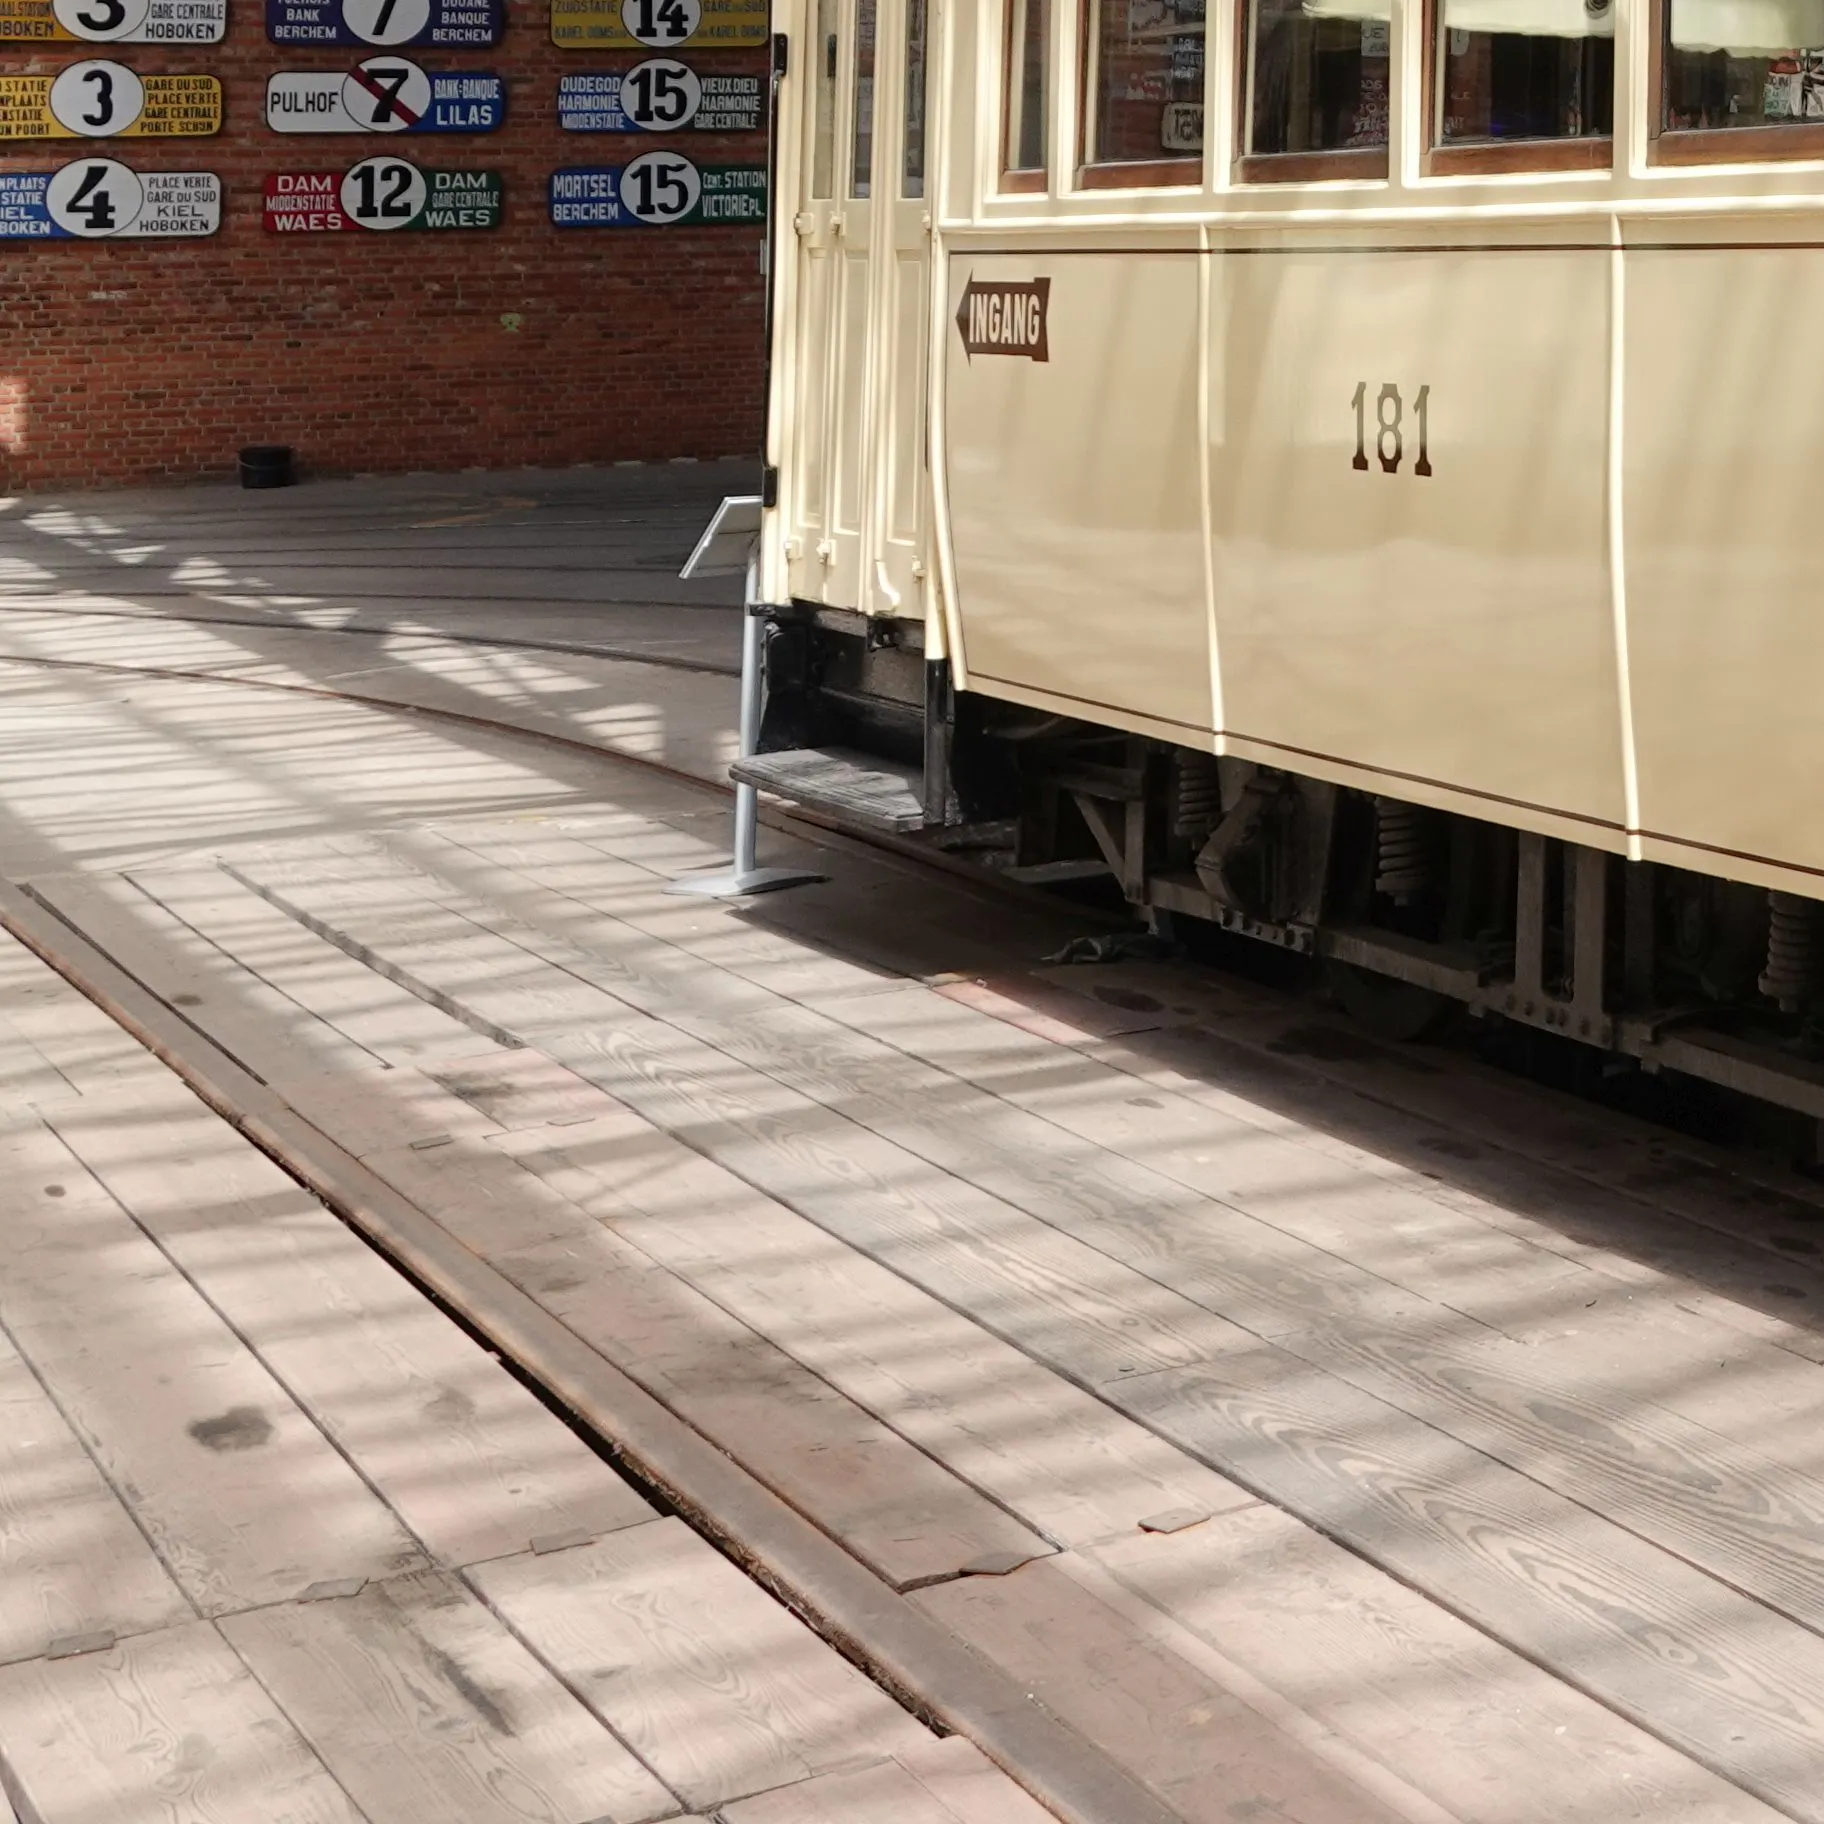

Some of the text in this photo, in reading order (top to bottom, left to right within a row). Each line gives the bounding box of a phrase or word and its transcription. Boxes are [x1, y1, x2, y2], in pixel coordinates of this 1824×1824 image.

[151, 3, 223, 20] GARE CENTRALE
[286, 8, 319, 21] BANK
[441, 12, 489, 25] BANQUE
[146, 23, 215, 39] HOBOKEN
[275, 26, 336, 38] BERCHEM
[432, 28, 492, 41] BERCHEM
[7, 80, 47, 92] STATIE
[146, 78, 212, 91] GARE DU SUD
[82, 69, 113, 126] 3
[148, 92, 218, 105] PLACE VERTE
[271, 92, 339, 113] PULHOF
[367, 69, 408, 122] 7
[558, 95, 620, 111] HARMONIE
[629, 68, 687, 122] 15
[702, 95, 760, 111] HARMONIE
[145, 107, 218, 119] GARE CENTRALE
[436, 105, 492, 126] LILAS
[562, 113, 626, 129] MIDDENSTATIE
[694, 113, 757, 129] GARE CENTRALE
[16, 123, 50, 136] POORT
[141, 121, 174, 133] PORTE
[149, 176, 211, 188] PLACE VERTE
[278, 175, 331, 192] DAM
[435, 173, 487, 189] DAM
[553, 174, 616, 199] MORTSEL
[724, 170, 766, 188] STATION
[66, 166, 115, 228] 4
[147, 191, 216, 203] GARE DU SUD
[351, 165, 412, 217] 12
[629, 164, 688, 215] 15
[1, 192, 44, 204] STATIE
[266, 194, 336, 211] MIDDENSTATIE
[432, 191, 499, 208] GARE CENTRALE
[157, 205, 204, 217] KIEL
[426, 210, 490, 227] WAES
[553, 202, 618, 221] BERCHEM
[139, 220, 209, 232] HOBOKEN
[274, 213, 342, 231] WAES
[969, 293, 1040, 345] INGANG
[1351, 381, 1432, 477] 181
